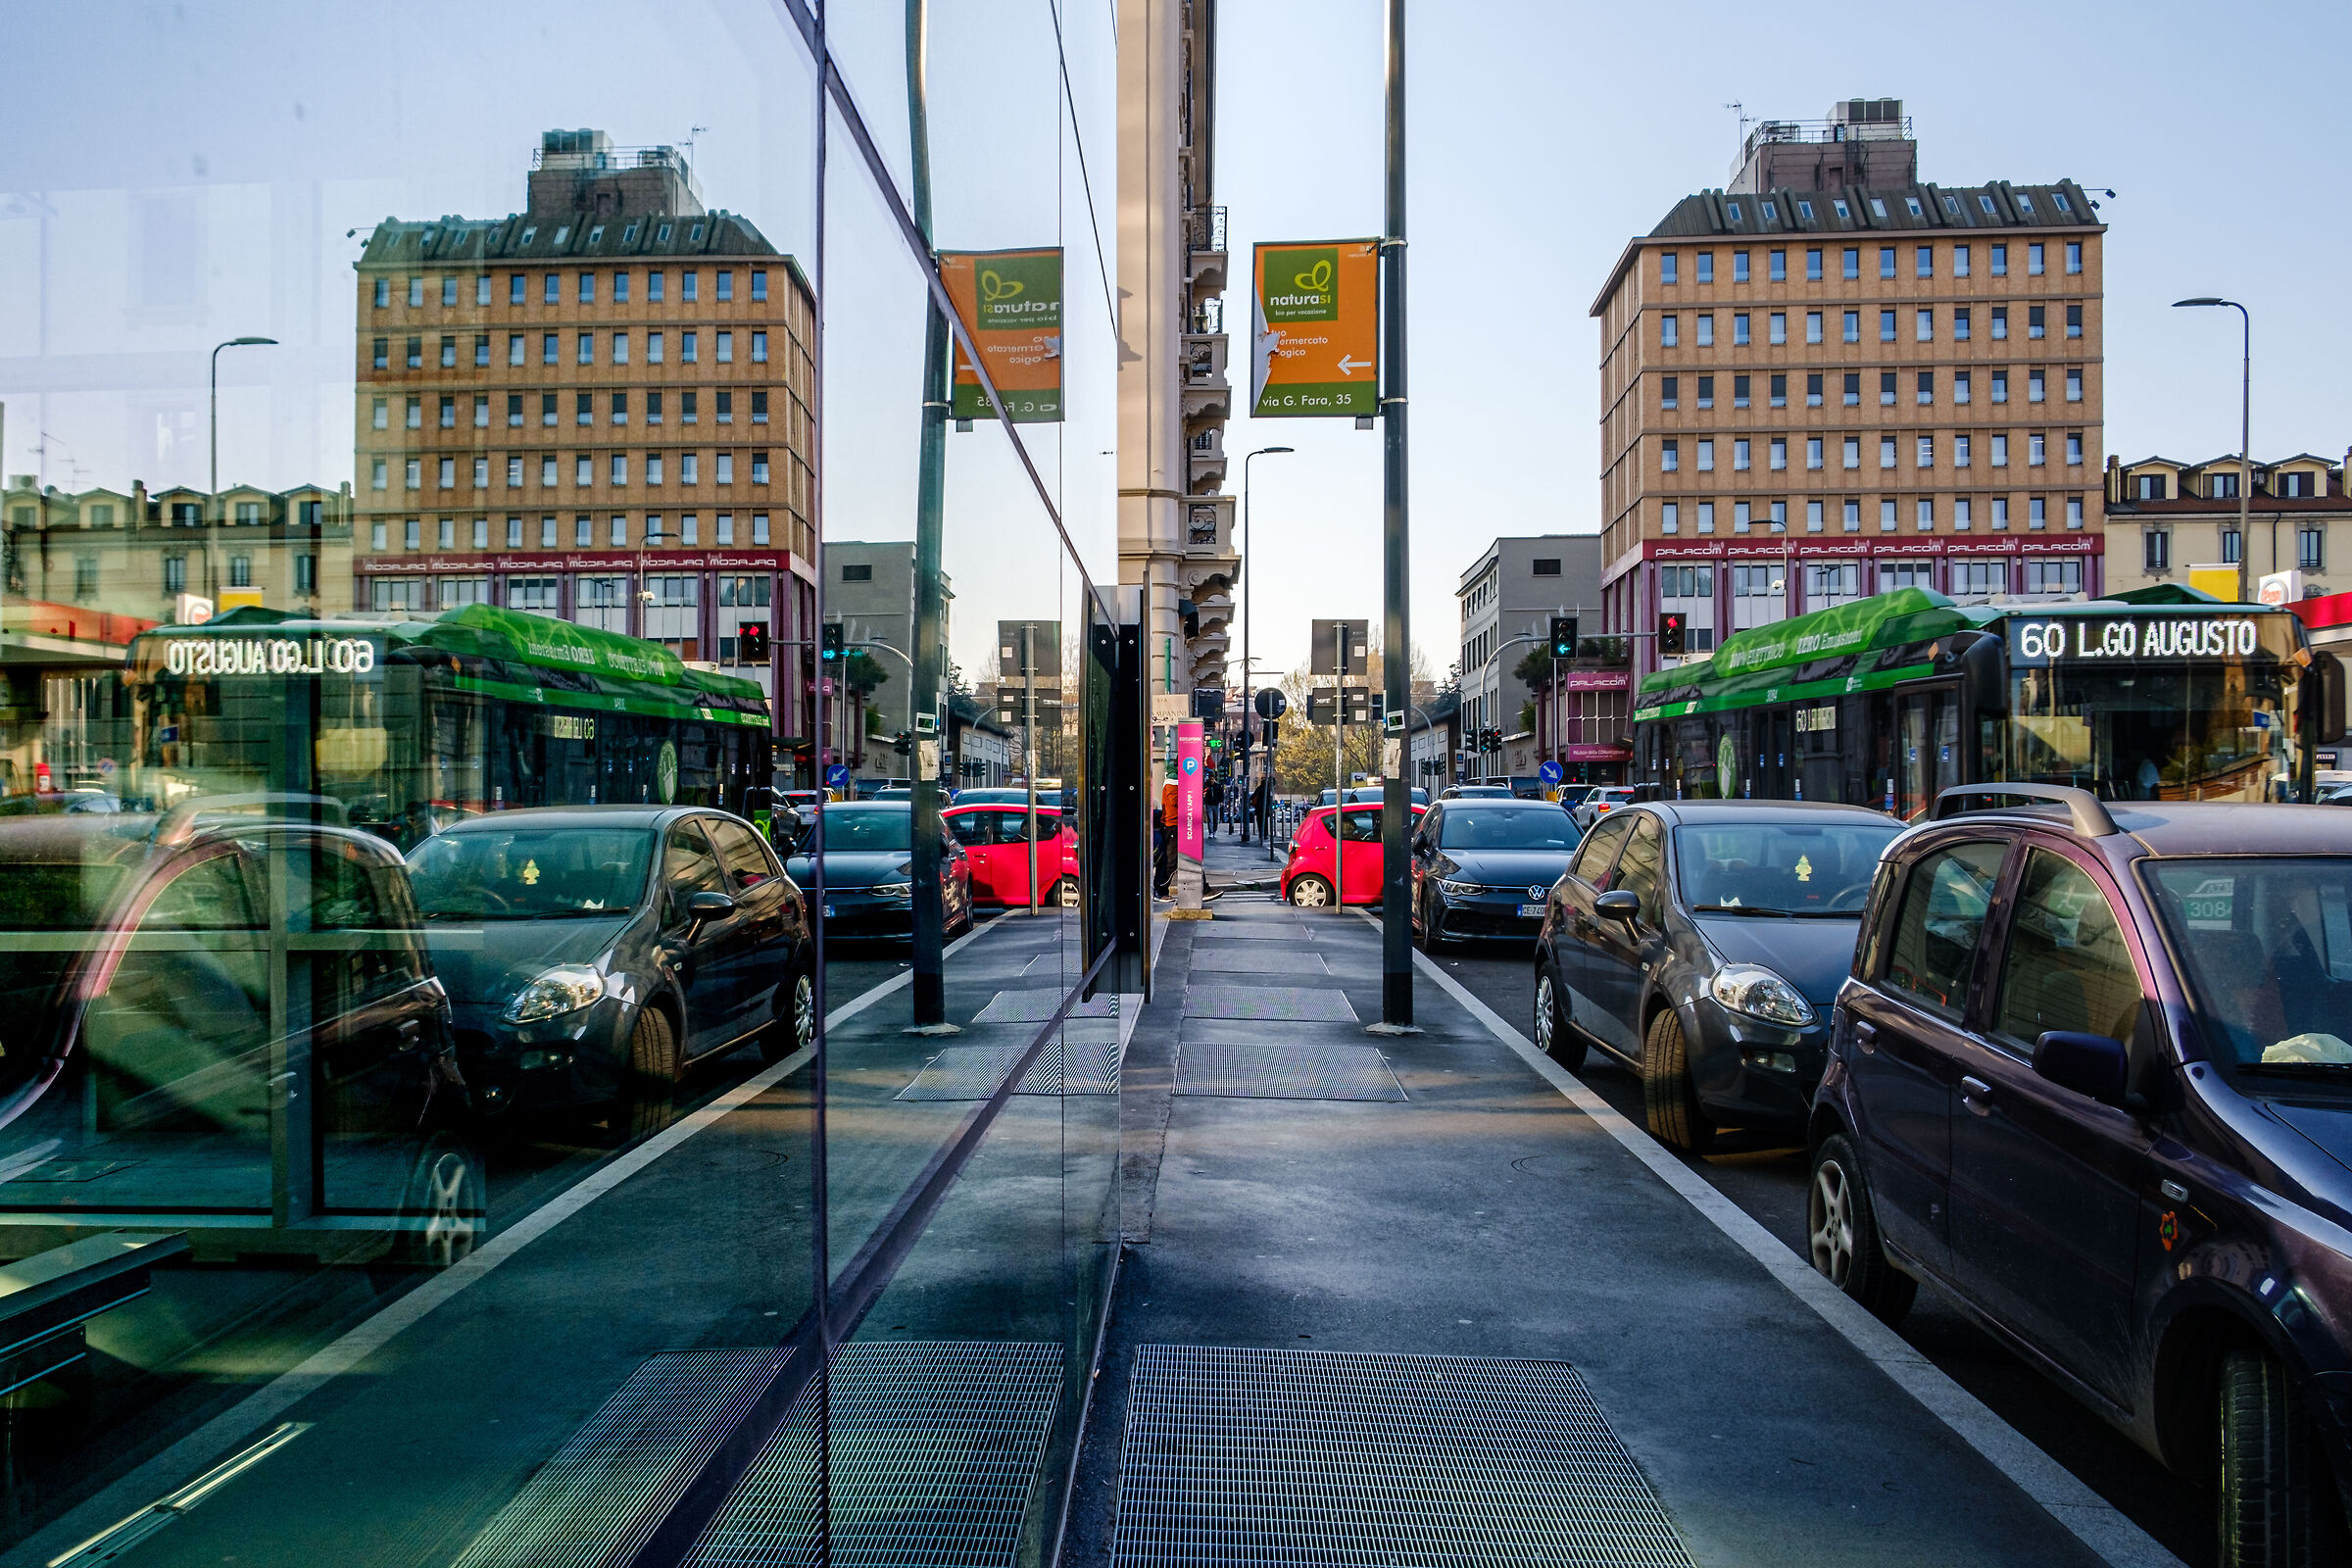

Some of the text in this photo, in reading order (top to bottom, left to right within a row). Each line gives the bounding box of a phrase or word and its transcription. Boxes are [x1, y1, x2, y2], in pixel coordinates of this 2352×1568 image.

[1280, 336, 1328, 345] ermercato
[1278, 348, 1305, 359] ogico
[1262, 394, 1351, 407] via G. Fara, 35
[1795, 634, 1821, 655] ZERO
[2021, 620, 2257, 658] 60 L.GO AUGUSTO
